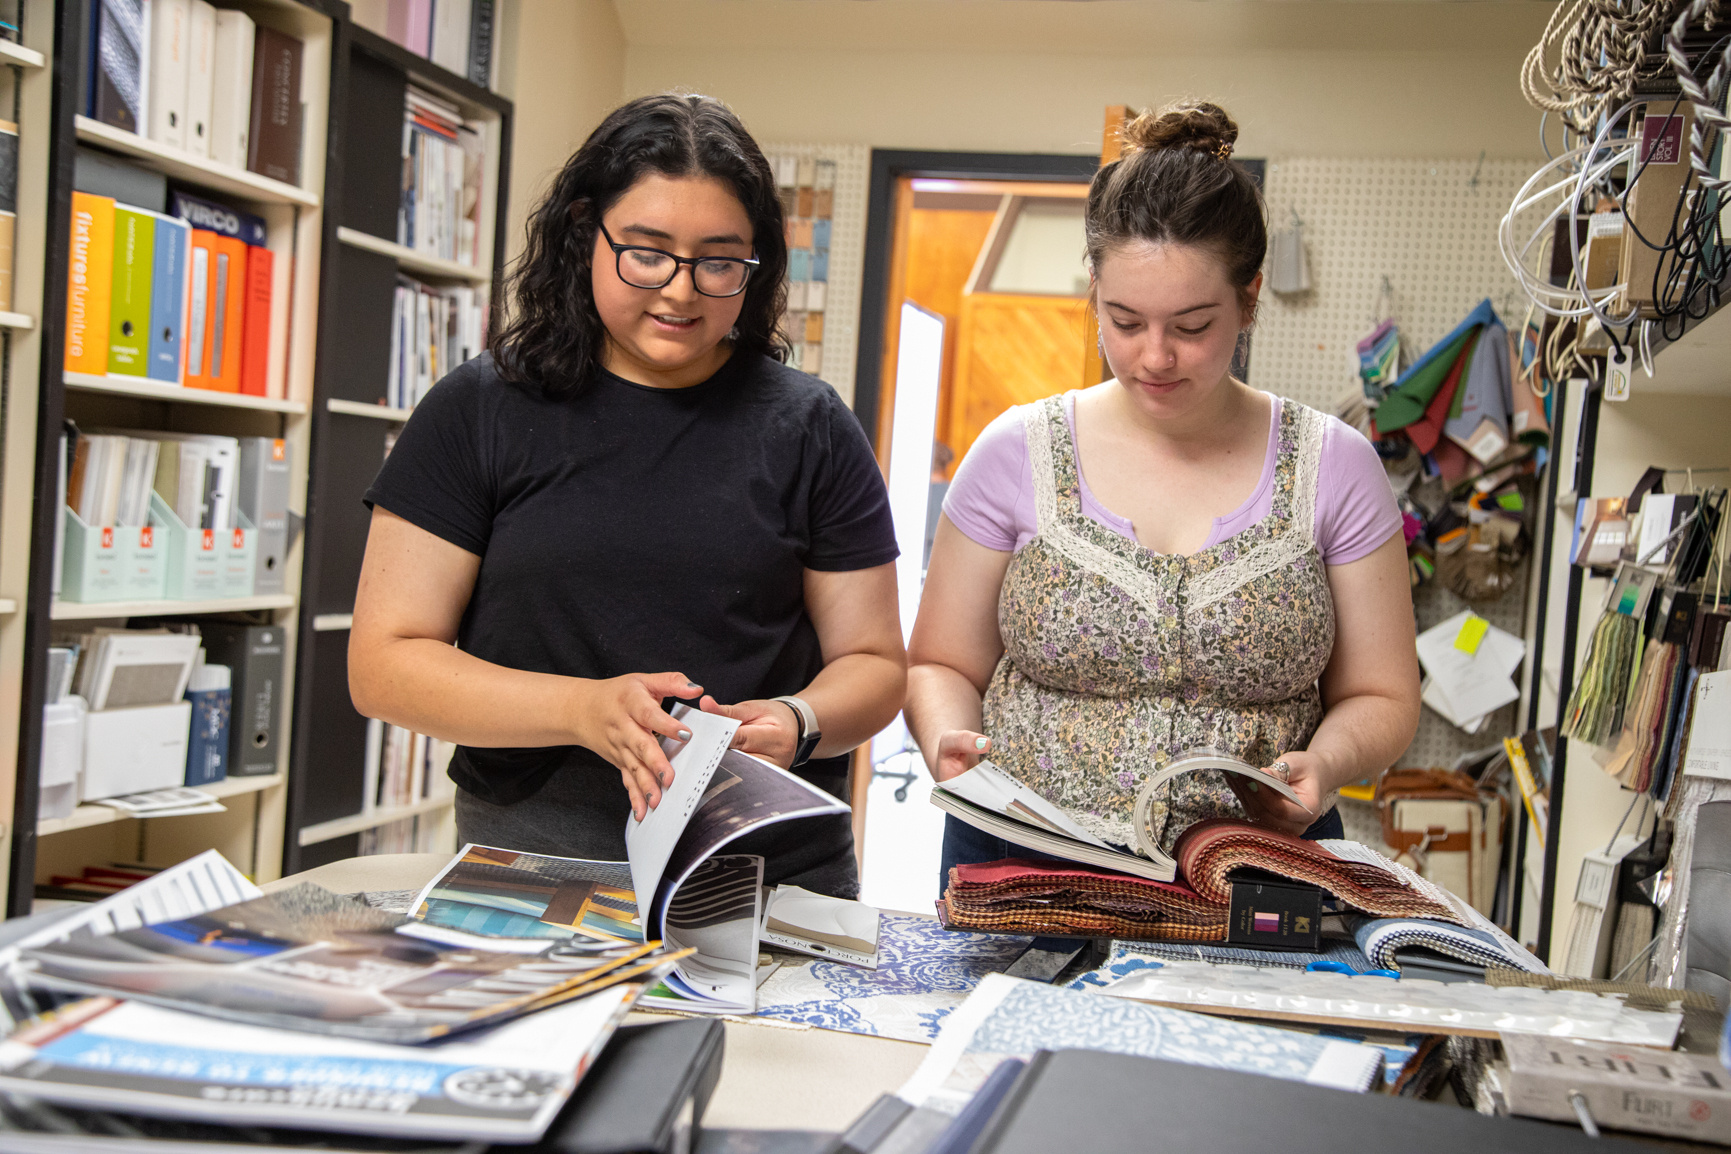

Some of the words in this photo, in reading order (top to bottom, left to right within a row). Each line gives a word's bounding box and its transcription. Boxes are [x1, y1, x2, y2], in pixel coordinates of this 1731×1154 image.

[1664, 144, 1673, 161] VOL
[179, 199, 240, 235] VIRCO
[768, 934, 869, 964] PORCENOSA
